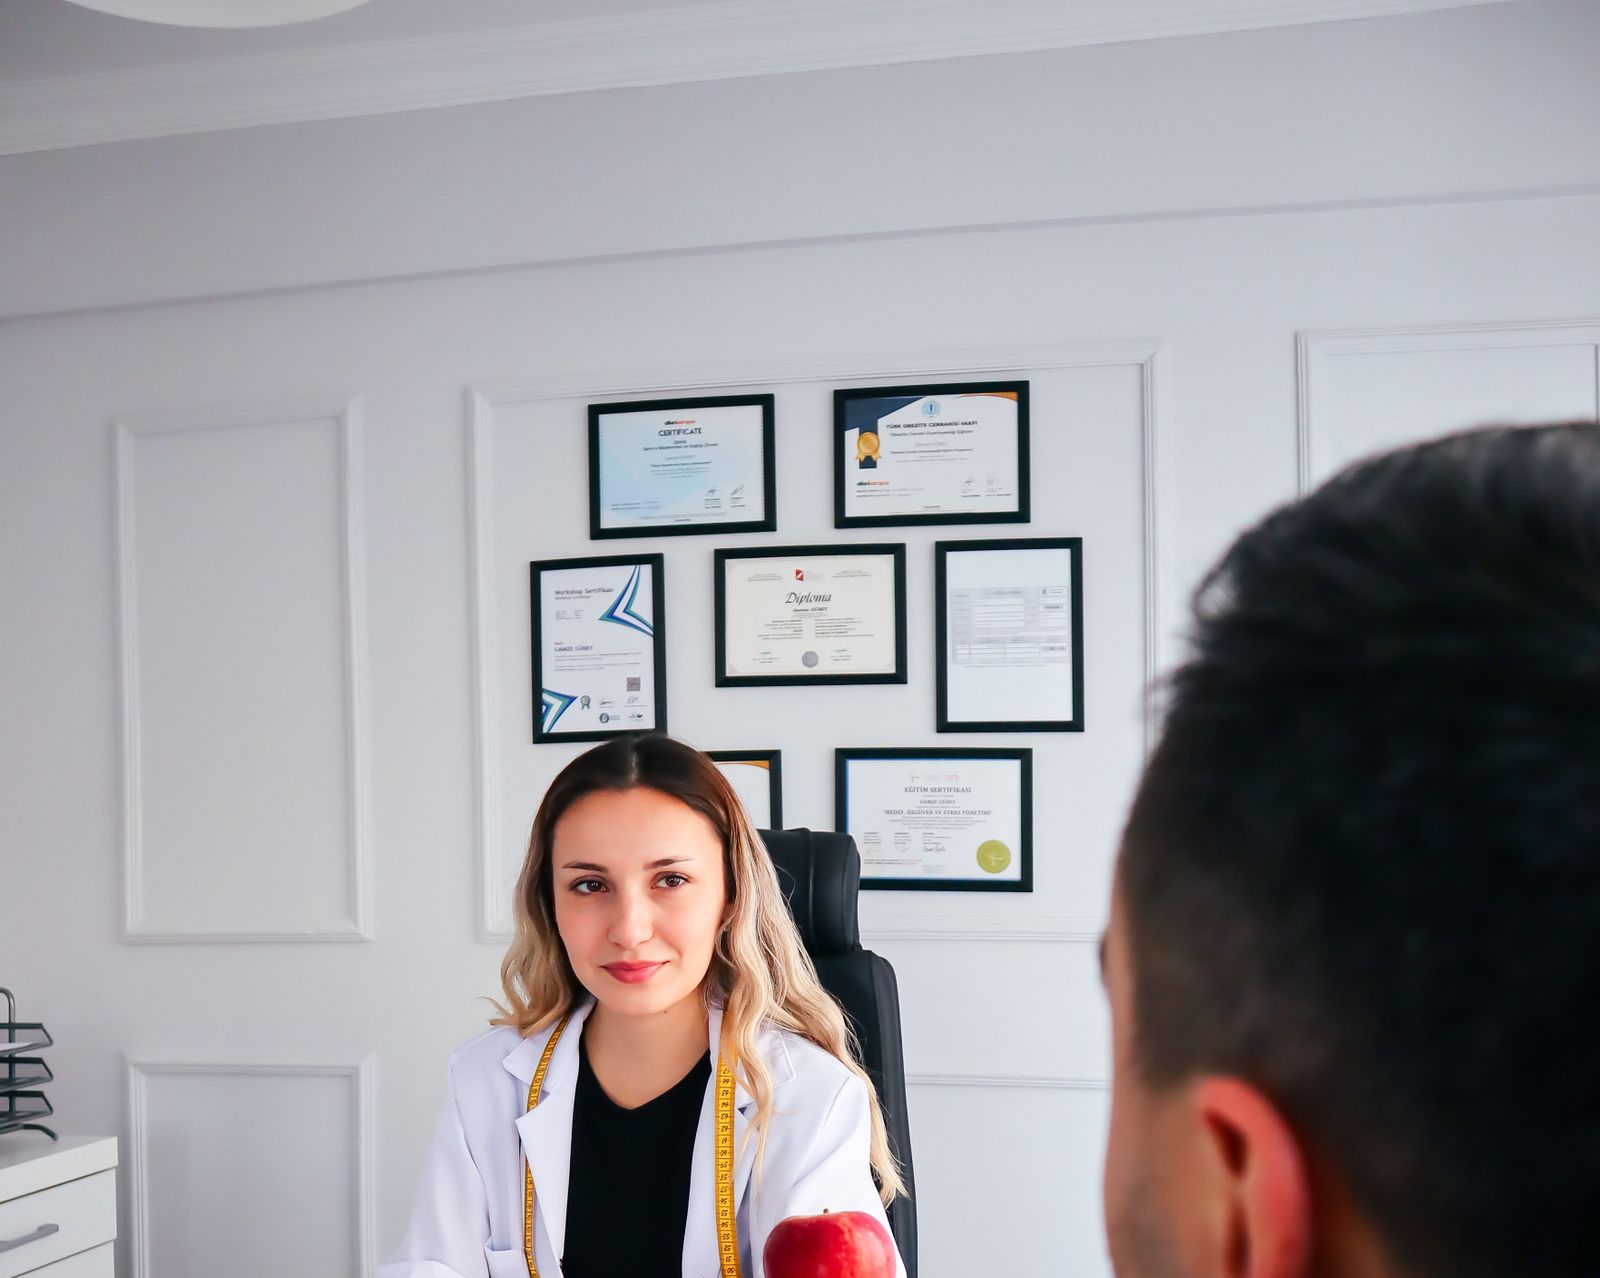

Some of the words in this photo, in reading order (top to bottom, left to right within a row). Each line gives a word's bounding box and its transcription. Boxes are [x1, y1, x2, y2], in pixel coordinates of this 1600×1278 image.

[658, 428, 702, 436] CERTIFICATE
[785, 592, 832, 605] Diploma
[721, 1101, 730, 1109] 64
[720, 1149, 728, 1157] 60
[720, 1161, 728, 1169] 59
[720, 1197, 728, 1205] 56
[723, 1244, 731, 1252] 52
